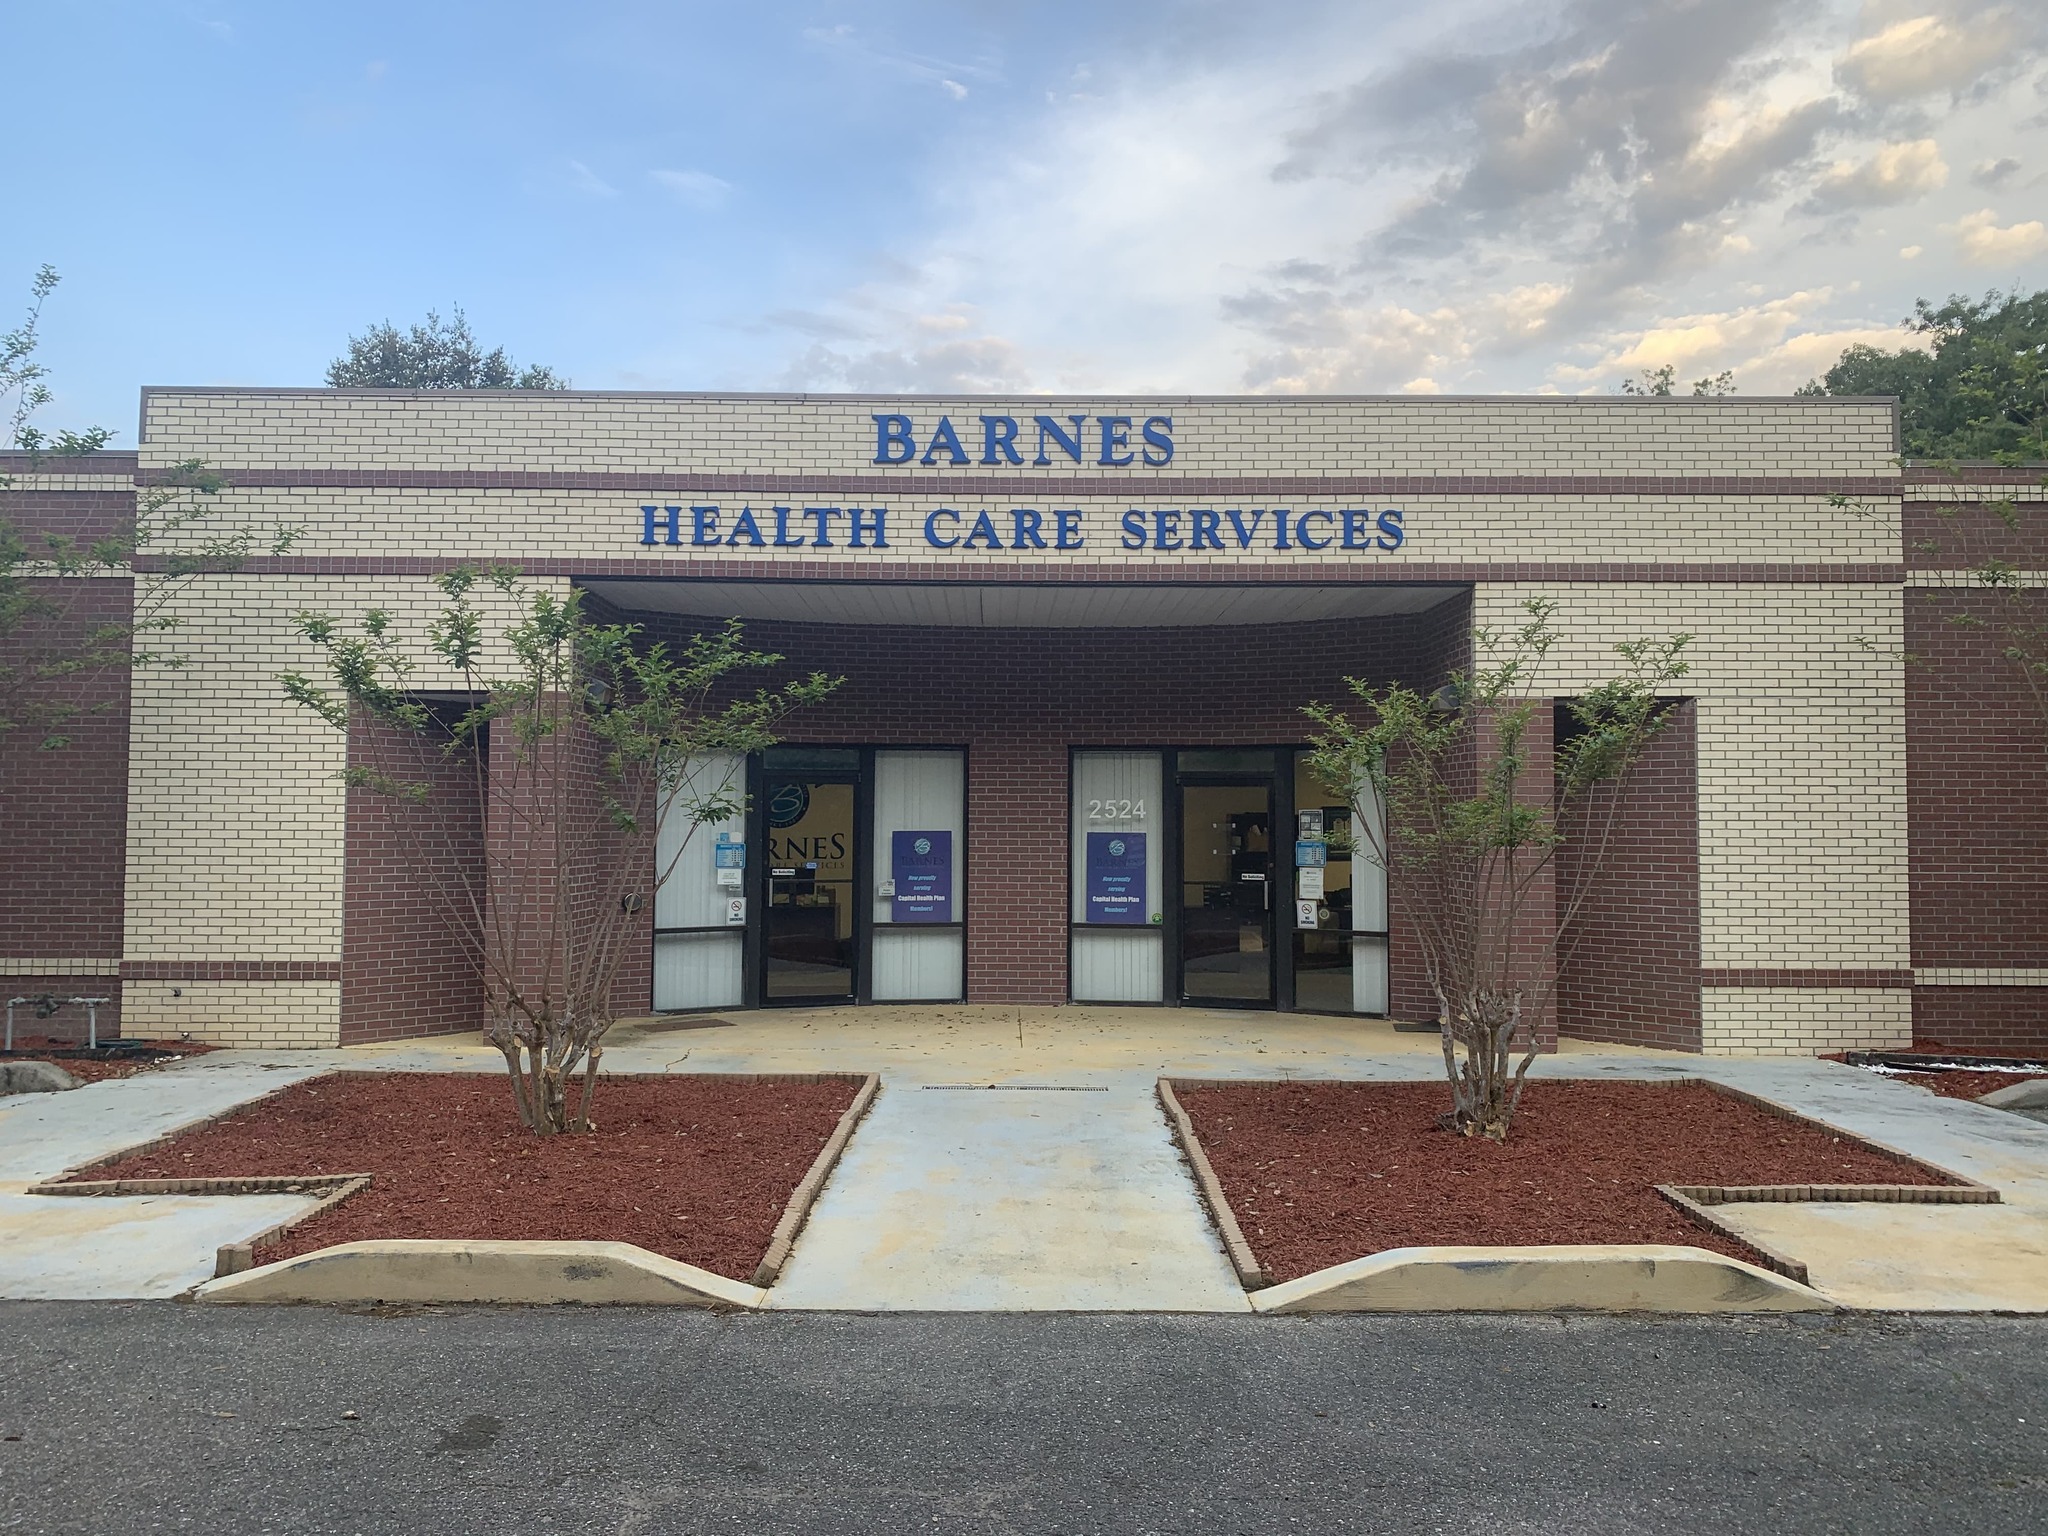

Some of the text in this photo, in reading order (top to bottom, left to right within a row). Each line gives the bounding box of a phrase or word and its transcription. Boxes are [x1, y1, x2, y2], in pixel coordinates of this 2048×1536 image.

[872, 414, 1175, 466] BARNES
[639, 505, 1405, 551] HEALTH CARE SERVICES
[1088, 799, 1147, 819] 2524
[769, 832, 845, 860] RNES
[1092, 895, 1110, 903] Capital
